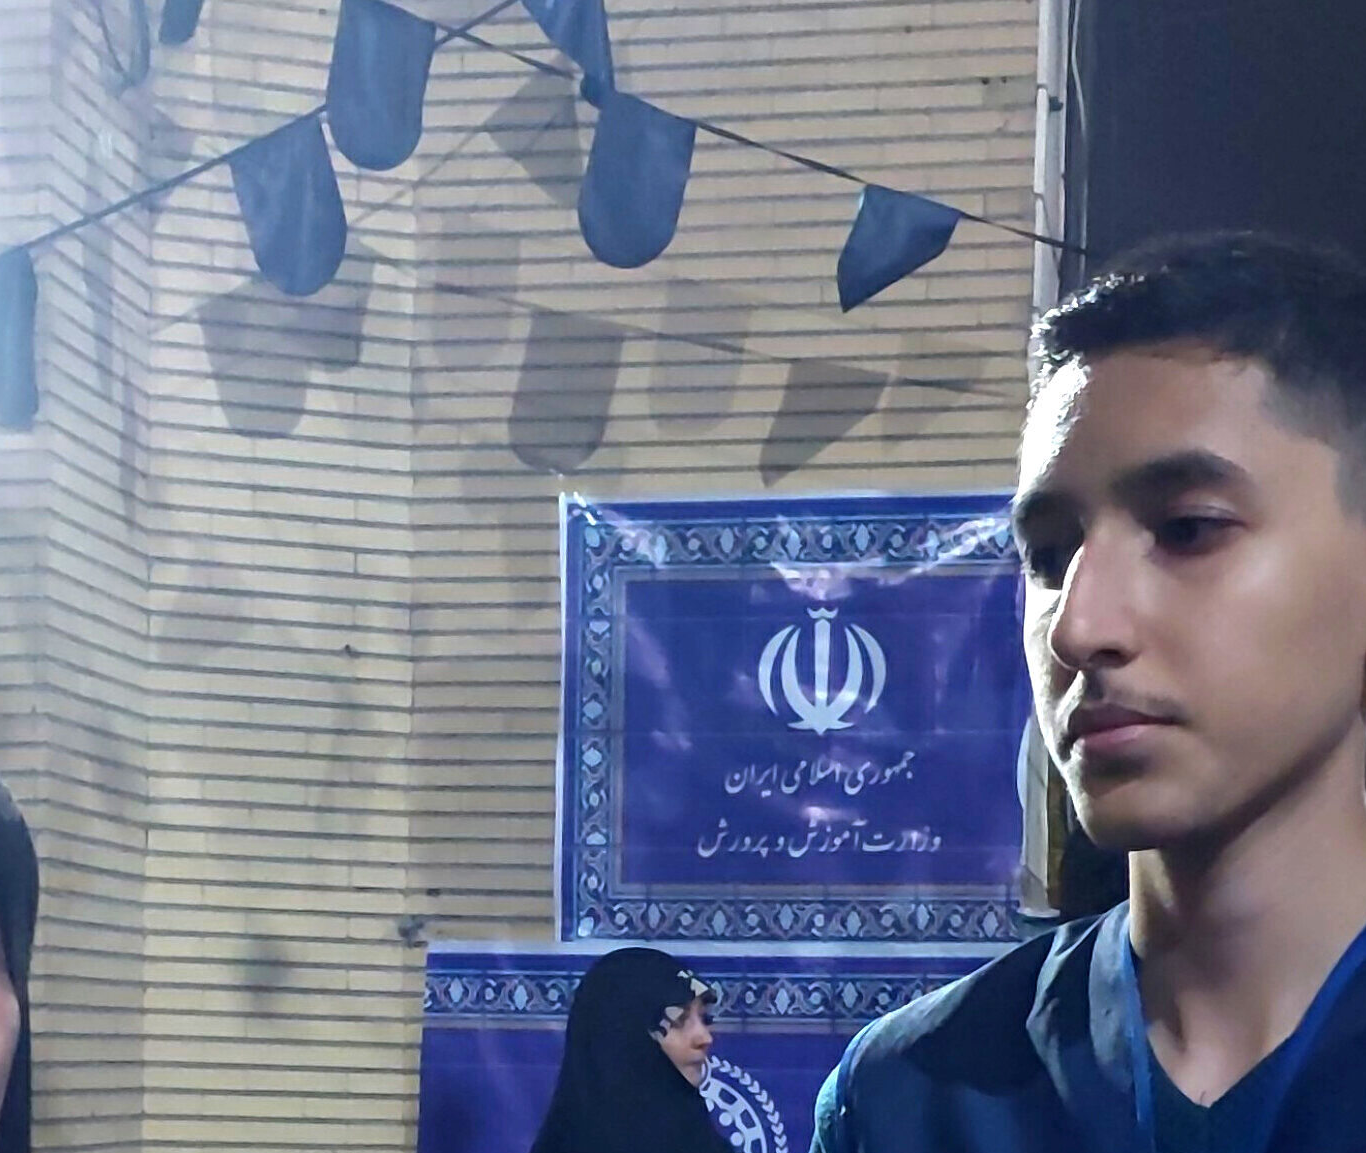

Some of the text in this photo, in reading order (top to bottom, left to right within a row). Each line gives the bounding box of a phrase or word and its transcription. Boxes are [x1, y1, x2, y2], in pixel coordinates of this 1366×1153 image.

[724, 751, 916, 798] جمهوری اسلامی ایران
[697, 815, 942, 858] وزارت آموزش و پرورش
